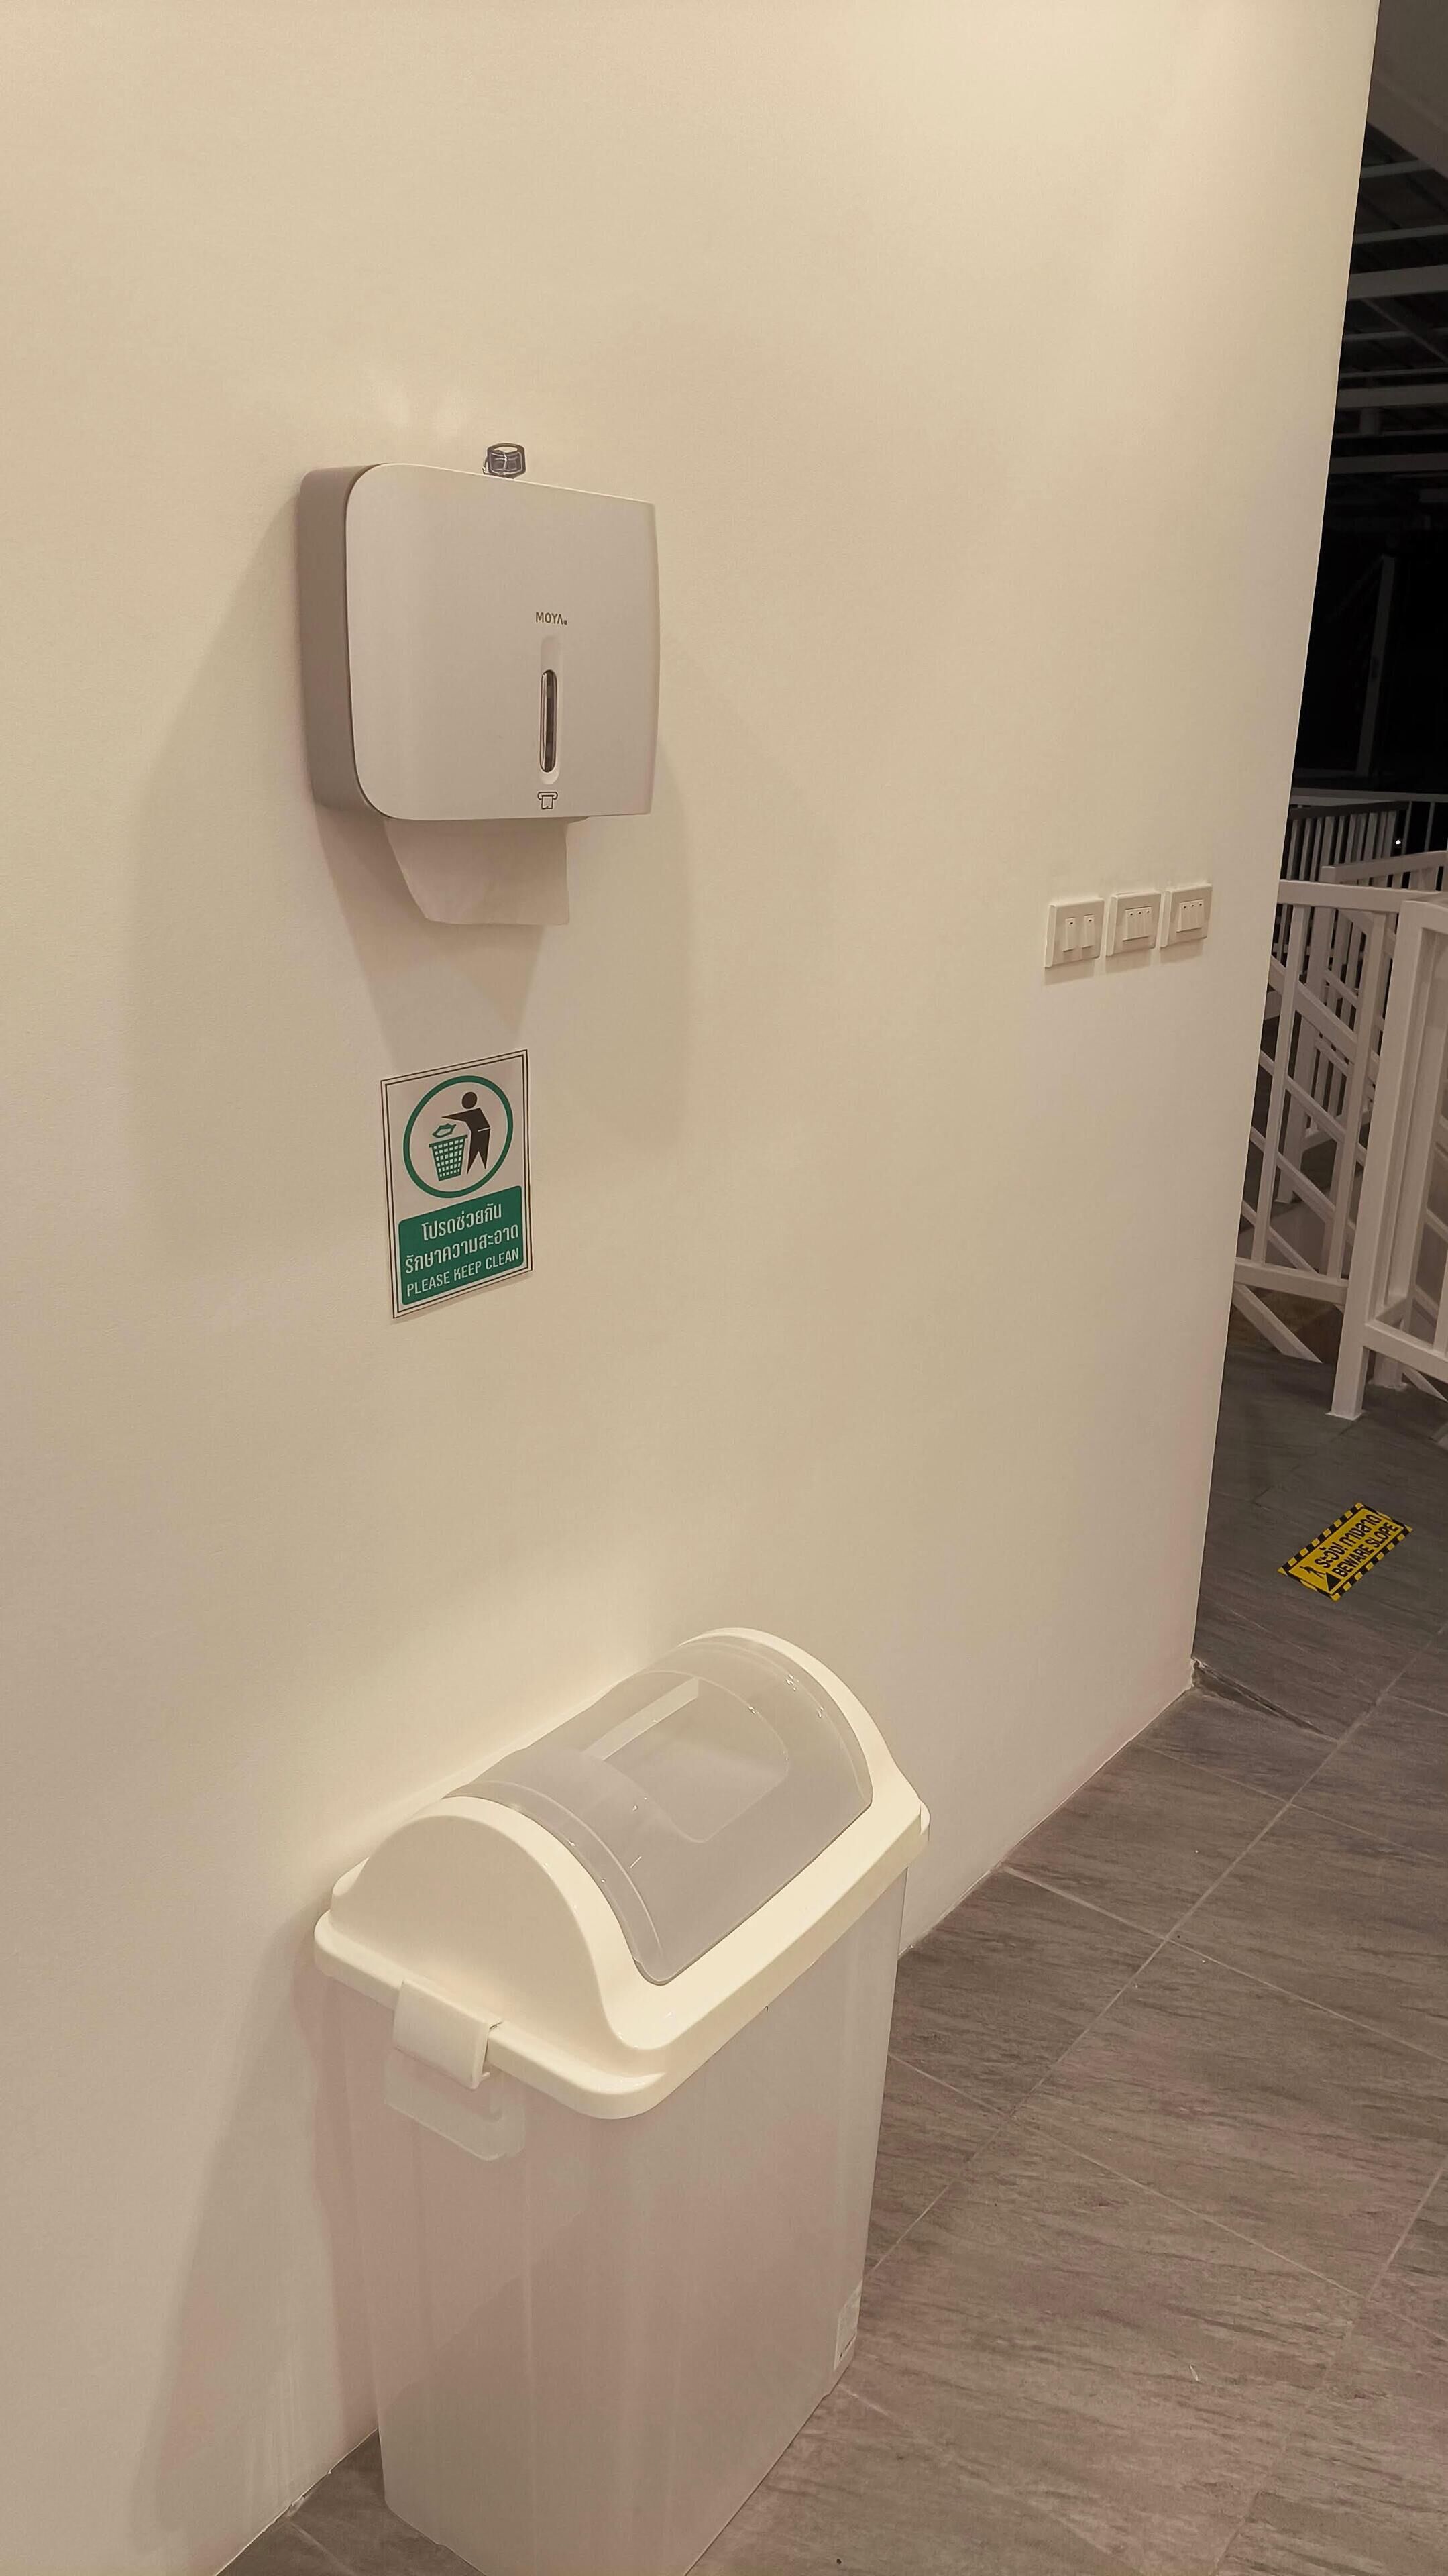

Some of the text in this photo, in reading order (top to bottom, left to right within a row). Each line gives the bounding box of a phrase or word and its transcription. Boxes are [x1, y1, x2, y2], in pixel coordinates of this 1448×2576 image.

[421, 1203, 502, 1241] โปรดช่วยกัน
[405, 1224, 519, 1273] รักษาความสะอาด
[407, 1247, 519, 1297] PLEASE KEEP CLEAN
[1331, 1522, 1400, 1578] BEWARE SLOPE
